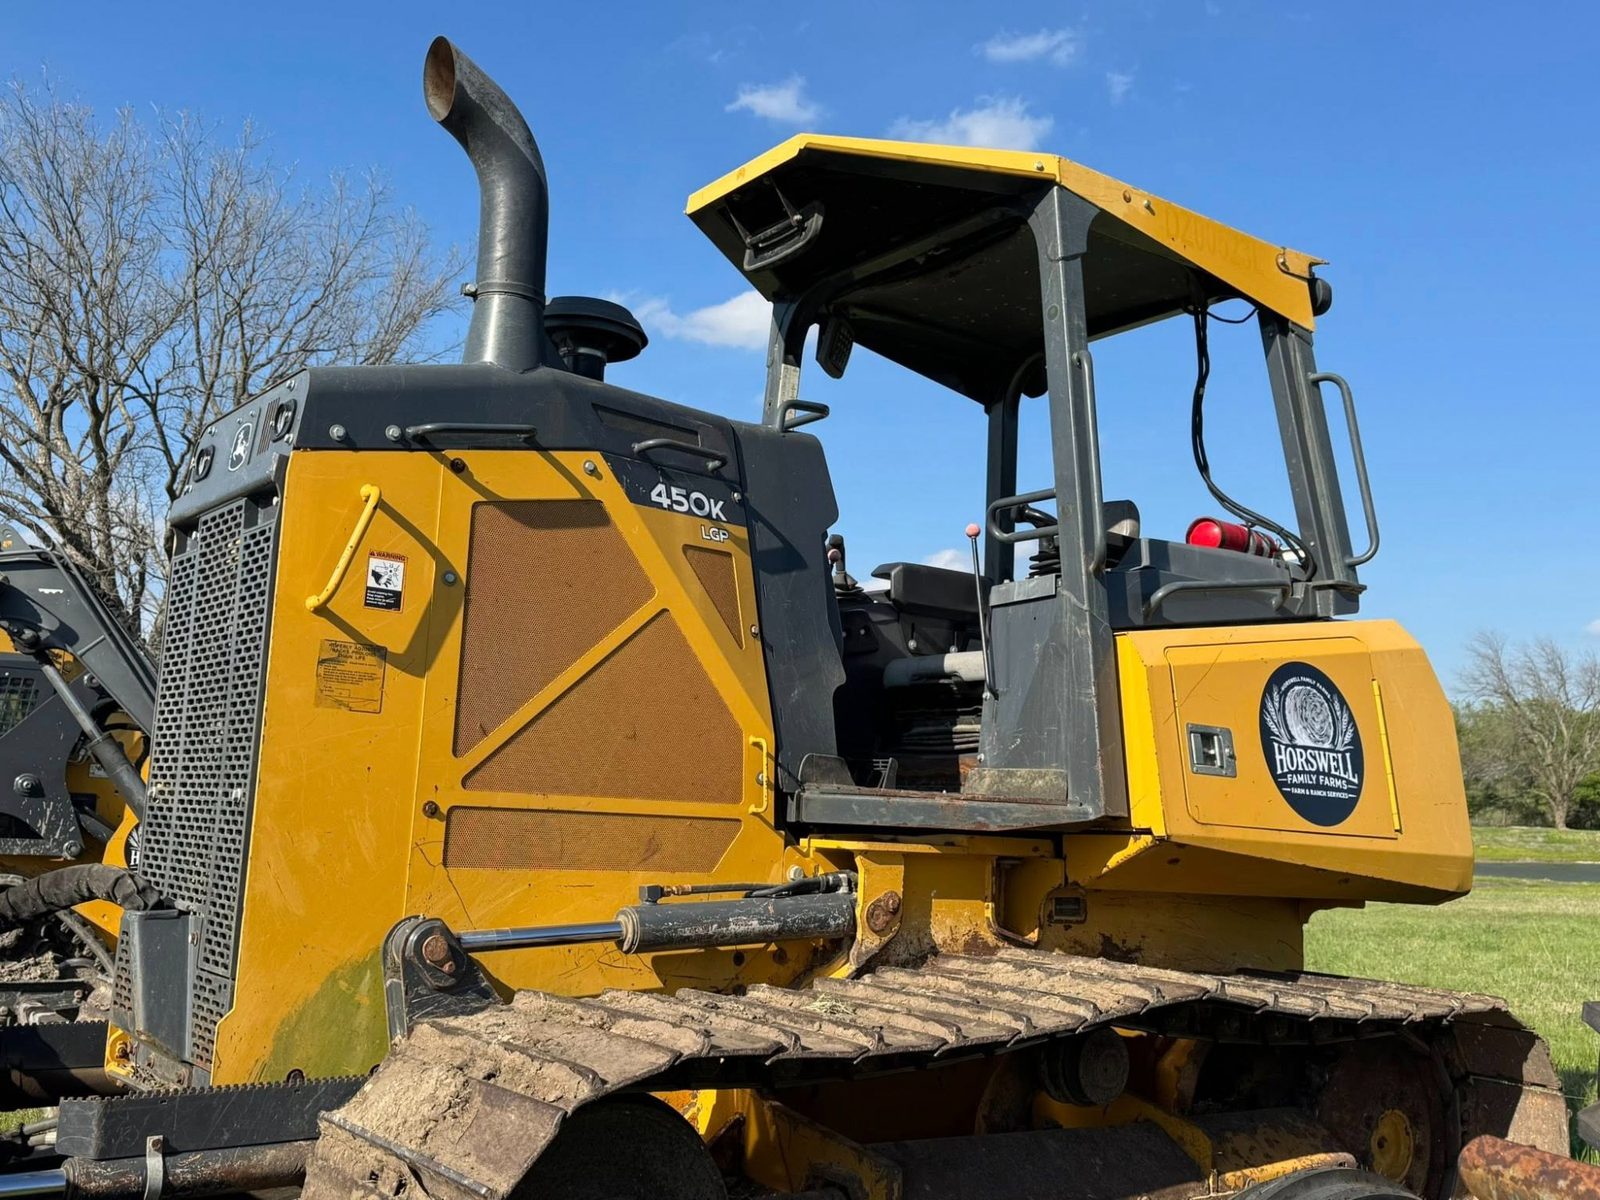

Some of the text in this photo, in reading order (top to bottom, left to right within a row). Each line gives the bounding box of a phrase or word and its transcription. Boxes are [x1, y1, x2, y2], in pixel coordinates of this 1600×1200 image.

[650, 483, 728, 521] 450K
[700, 525, 729, 542] LGP
[376, 551, 405, 561] WARNING
[1273, 742, 1359, 784] HORSWELL
[1287, 773, 1348, 790] FAMILY FARMS
[1291, 787, 1306, 795] FARM
[1310, 789, 1326, 797] RANCH
[1327, 790, 1349, 799] SERVICES
